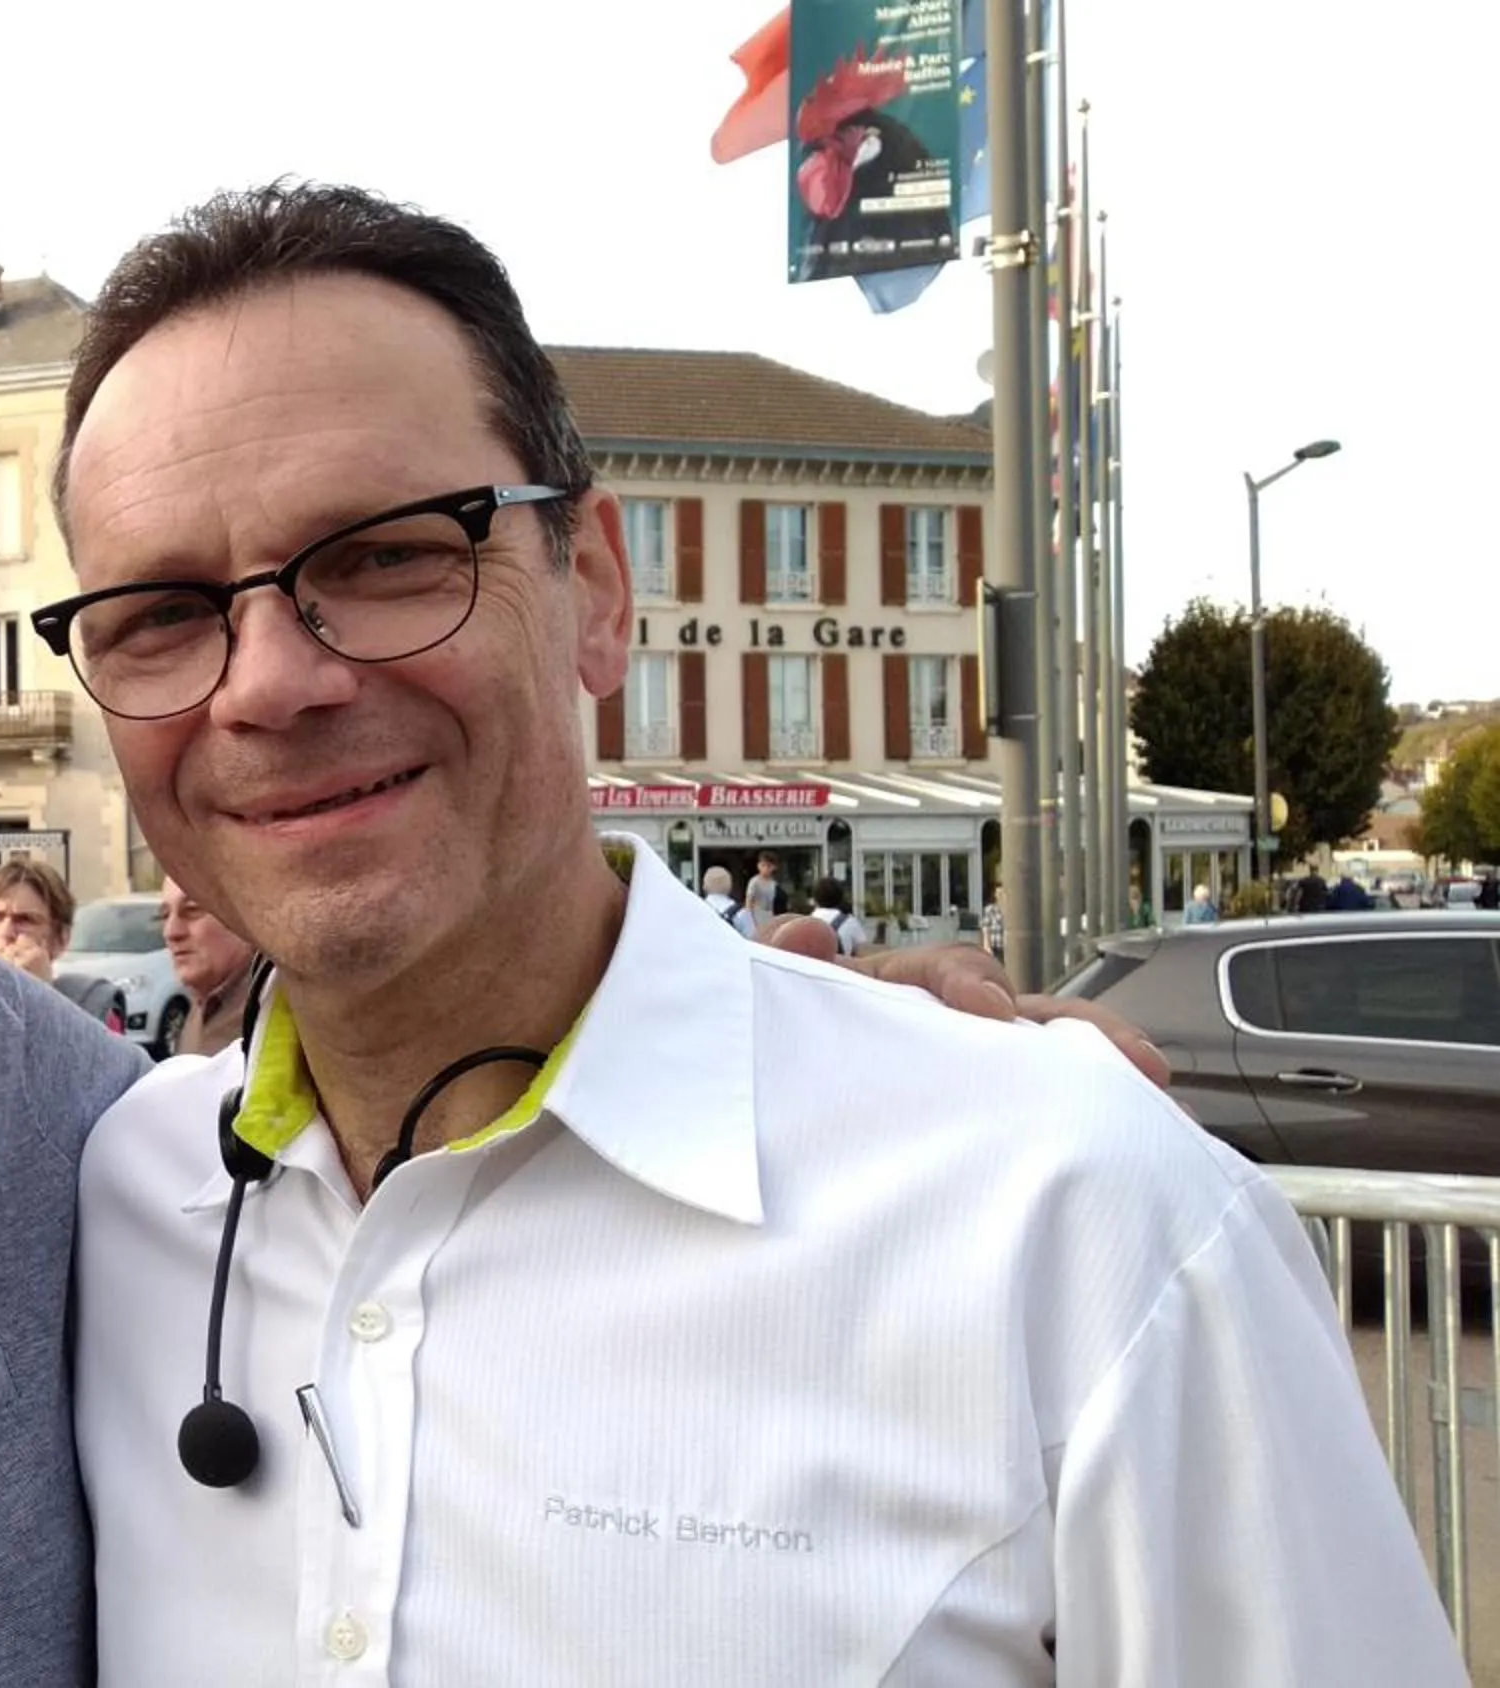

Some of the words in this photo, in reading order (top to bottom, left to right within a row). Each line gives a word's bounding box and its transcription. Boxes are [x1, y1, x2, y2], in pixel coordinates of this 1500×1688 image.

[679, 618, 723, 646] de
[750, 619, 785, 647] la
[812, 617, 908, 648] Gare
[709, 785, 816, 805] BRASSERIE
[545, 1496, 660, 1539] Patrick
[676, 1515, 813, 1552] Bertron
